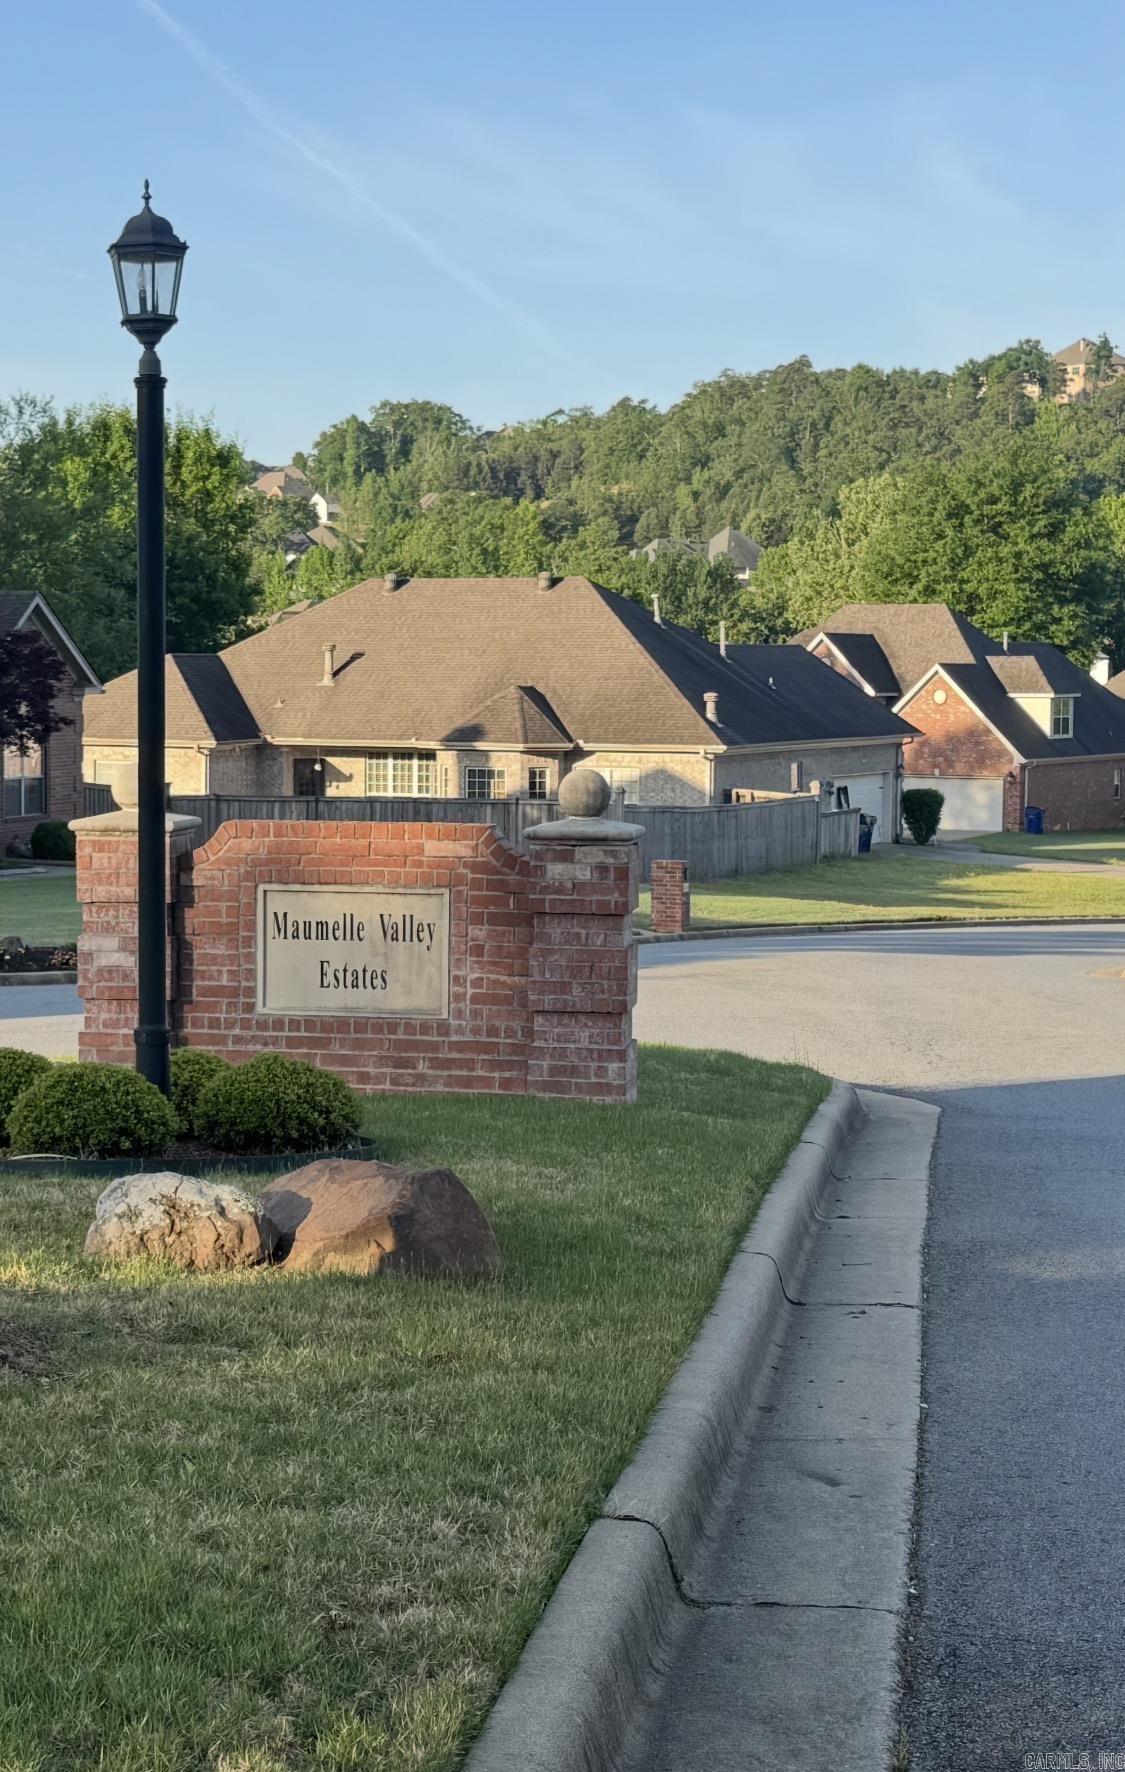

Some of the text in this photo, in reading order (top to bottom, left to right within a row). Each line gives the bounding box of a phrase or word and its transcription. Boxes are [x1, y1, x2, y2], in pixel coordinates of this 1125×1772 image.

[272, 911, 436, 951] Maumelle Valley
[319, 960, 388, 990] Estates
